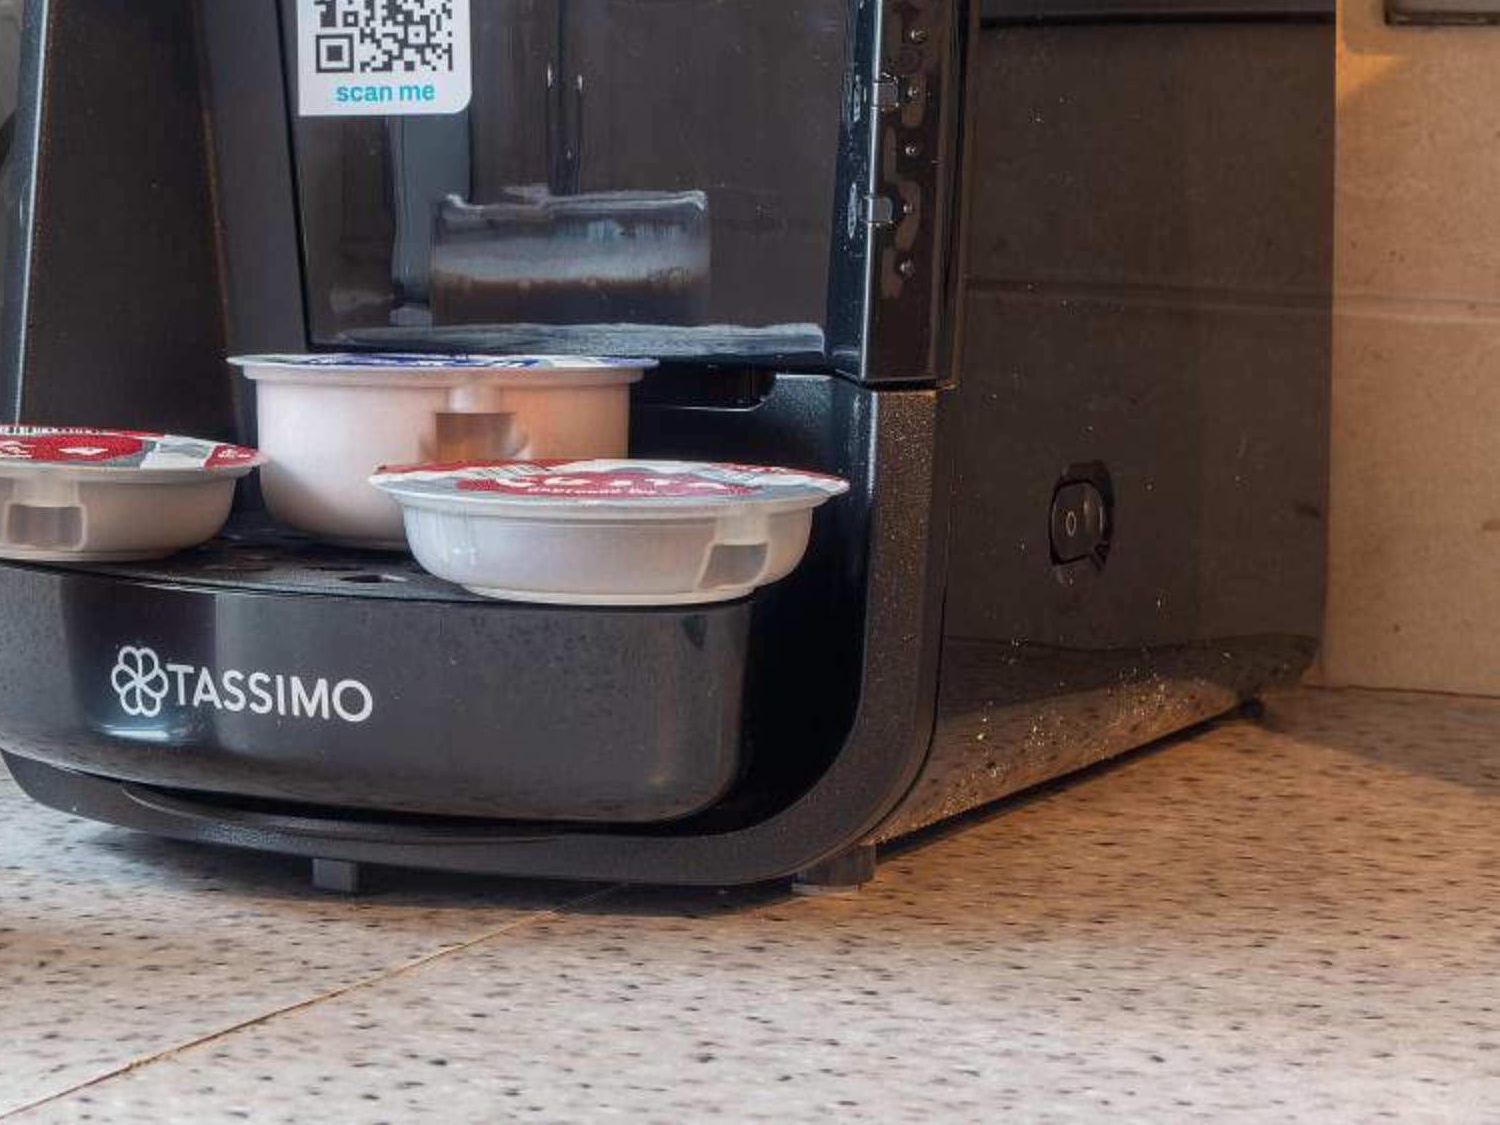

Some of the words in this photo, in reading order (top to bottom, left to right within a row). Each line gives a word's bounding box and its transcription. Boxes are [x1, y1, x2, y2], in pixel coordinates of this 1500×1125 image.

[336, 85, 392, 102] scan
[399, 83, 435, 101] me
[166, 663, 373, 722] TASSIMO
